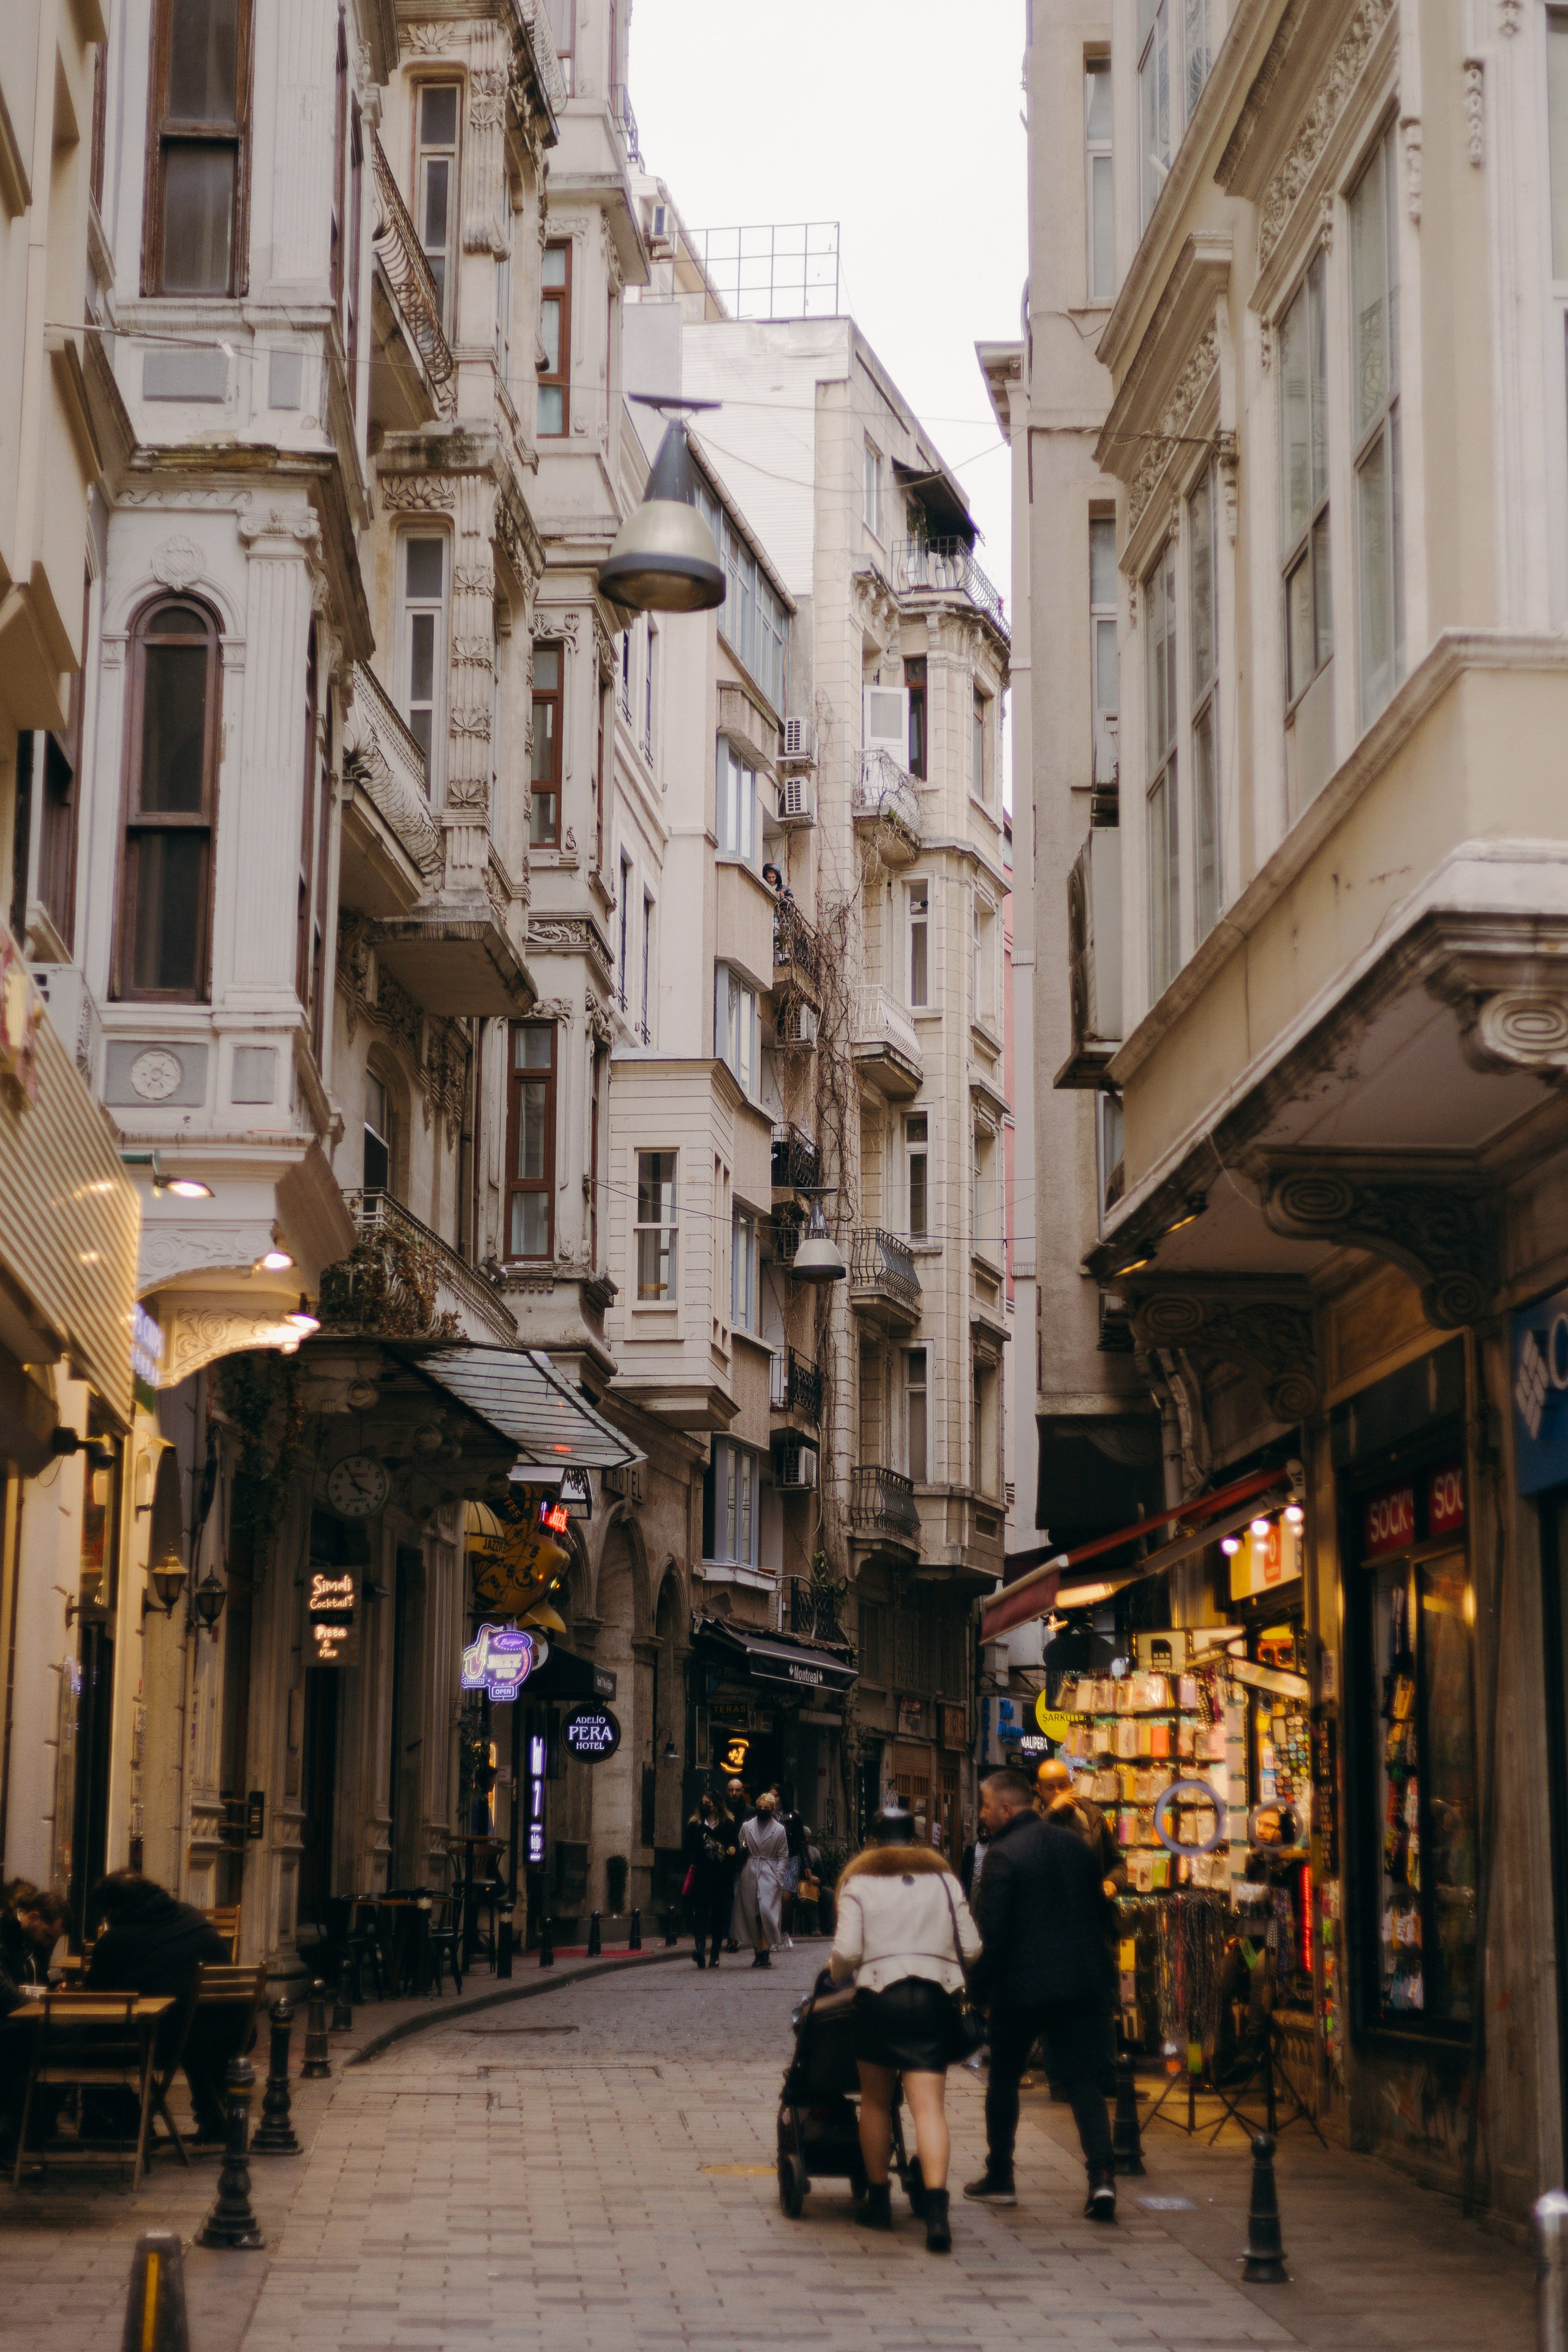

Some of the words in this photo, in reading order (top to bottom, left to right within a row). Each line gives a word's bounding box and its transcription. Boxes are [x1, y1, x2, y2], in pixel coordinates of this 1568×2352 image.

[612, 1468, 641, 1499] HOTEL
[309, 1596, 347, 1610] Cocktail
[315, 1611, 347, 1623] Burger
[316, 1626, 347, 1639] Pizza
[500, 1638, 523, 1647] Burger
[319, 1649, 337, 1657] More
[486, 1654, 522, 1669] JAZZ
[496, 1668, 516, 1678] PUB
[794, 1664, 819, 1684] Montreal
[568, 1725, 613, 1741] PERA
[576, 1741, 605, 1750] HOTEL
